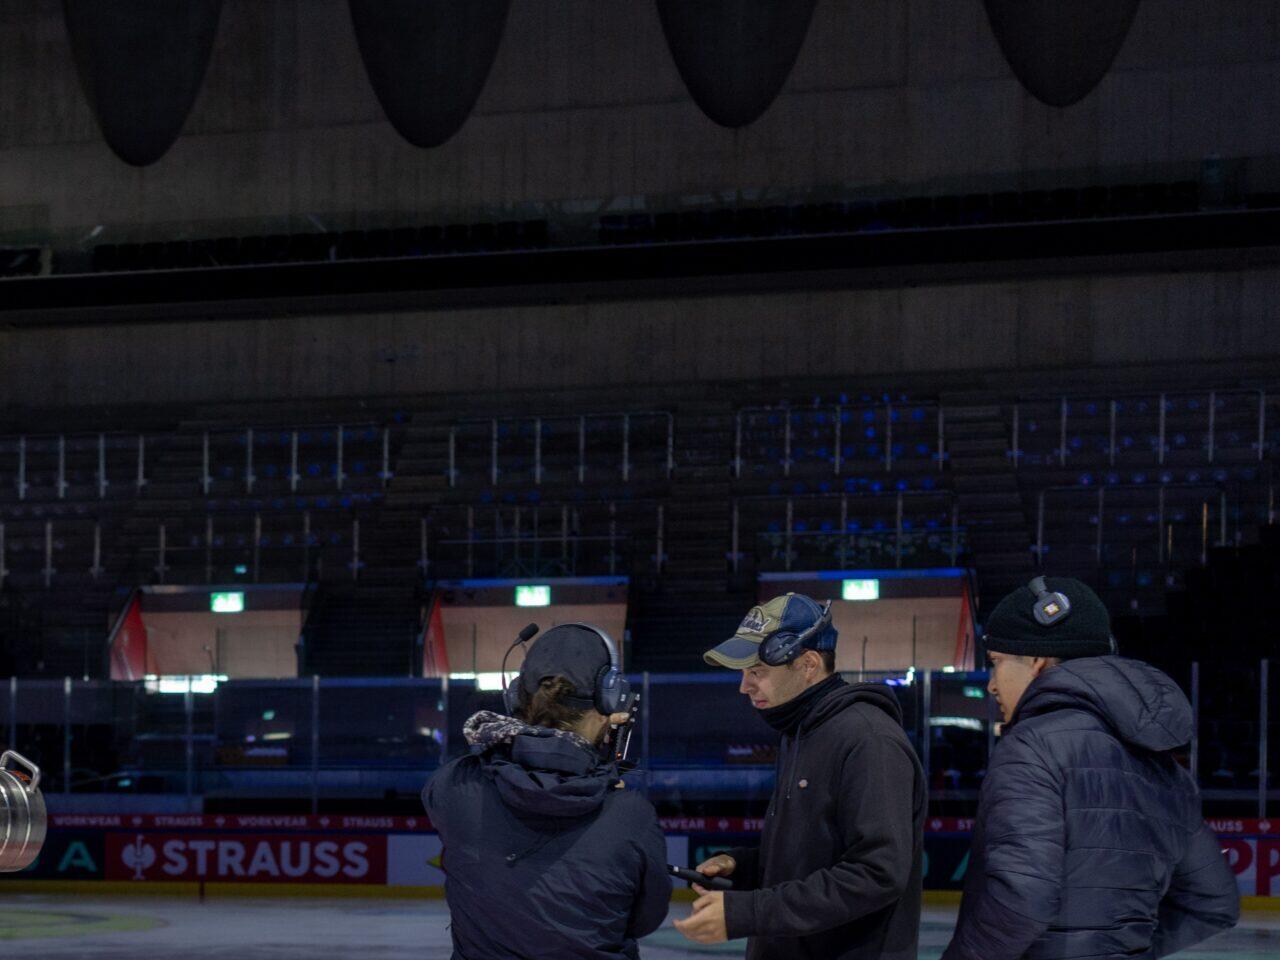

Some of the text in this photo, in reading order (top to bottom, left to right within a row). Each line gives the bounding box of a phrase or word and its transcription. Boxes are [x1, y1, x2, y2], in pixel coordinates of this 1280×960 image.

[53, 816, 394, 828] WORKWEAR STRAUSS WORKWEAR STRAUSS
[162, 840, 370, 878] STRAUSS
